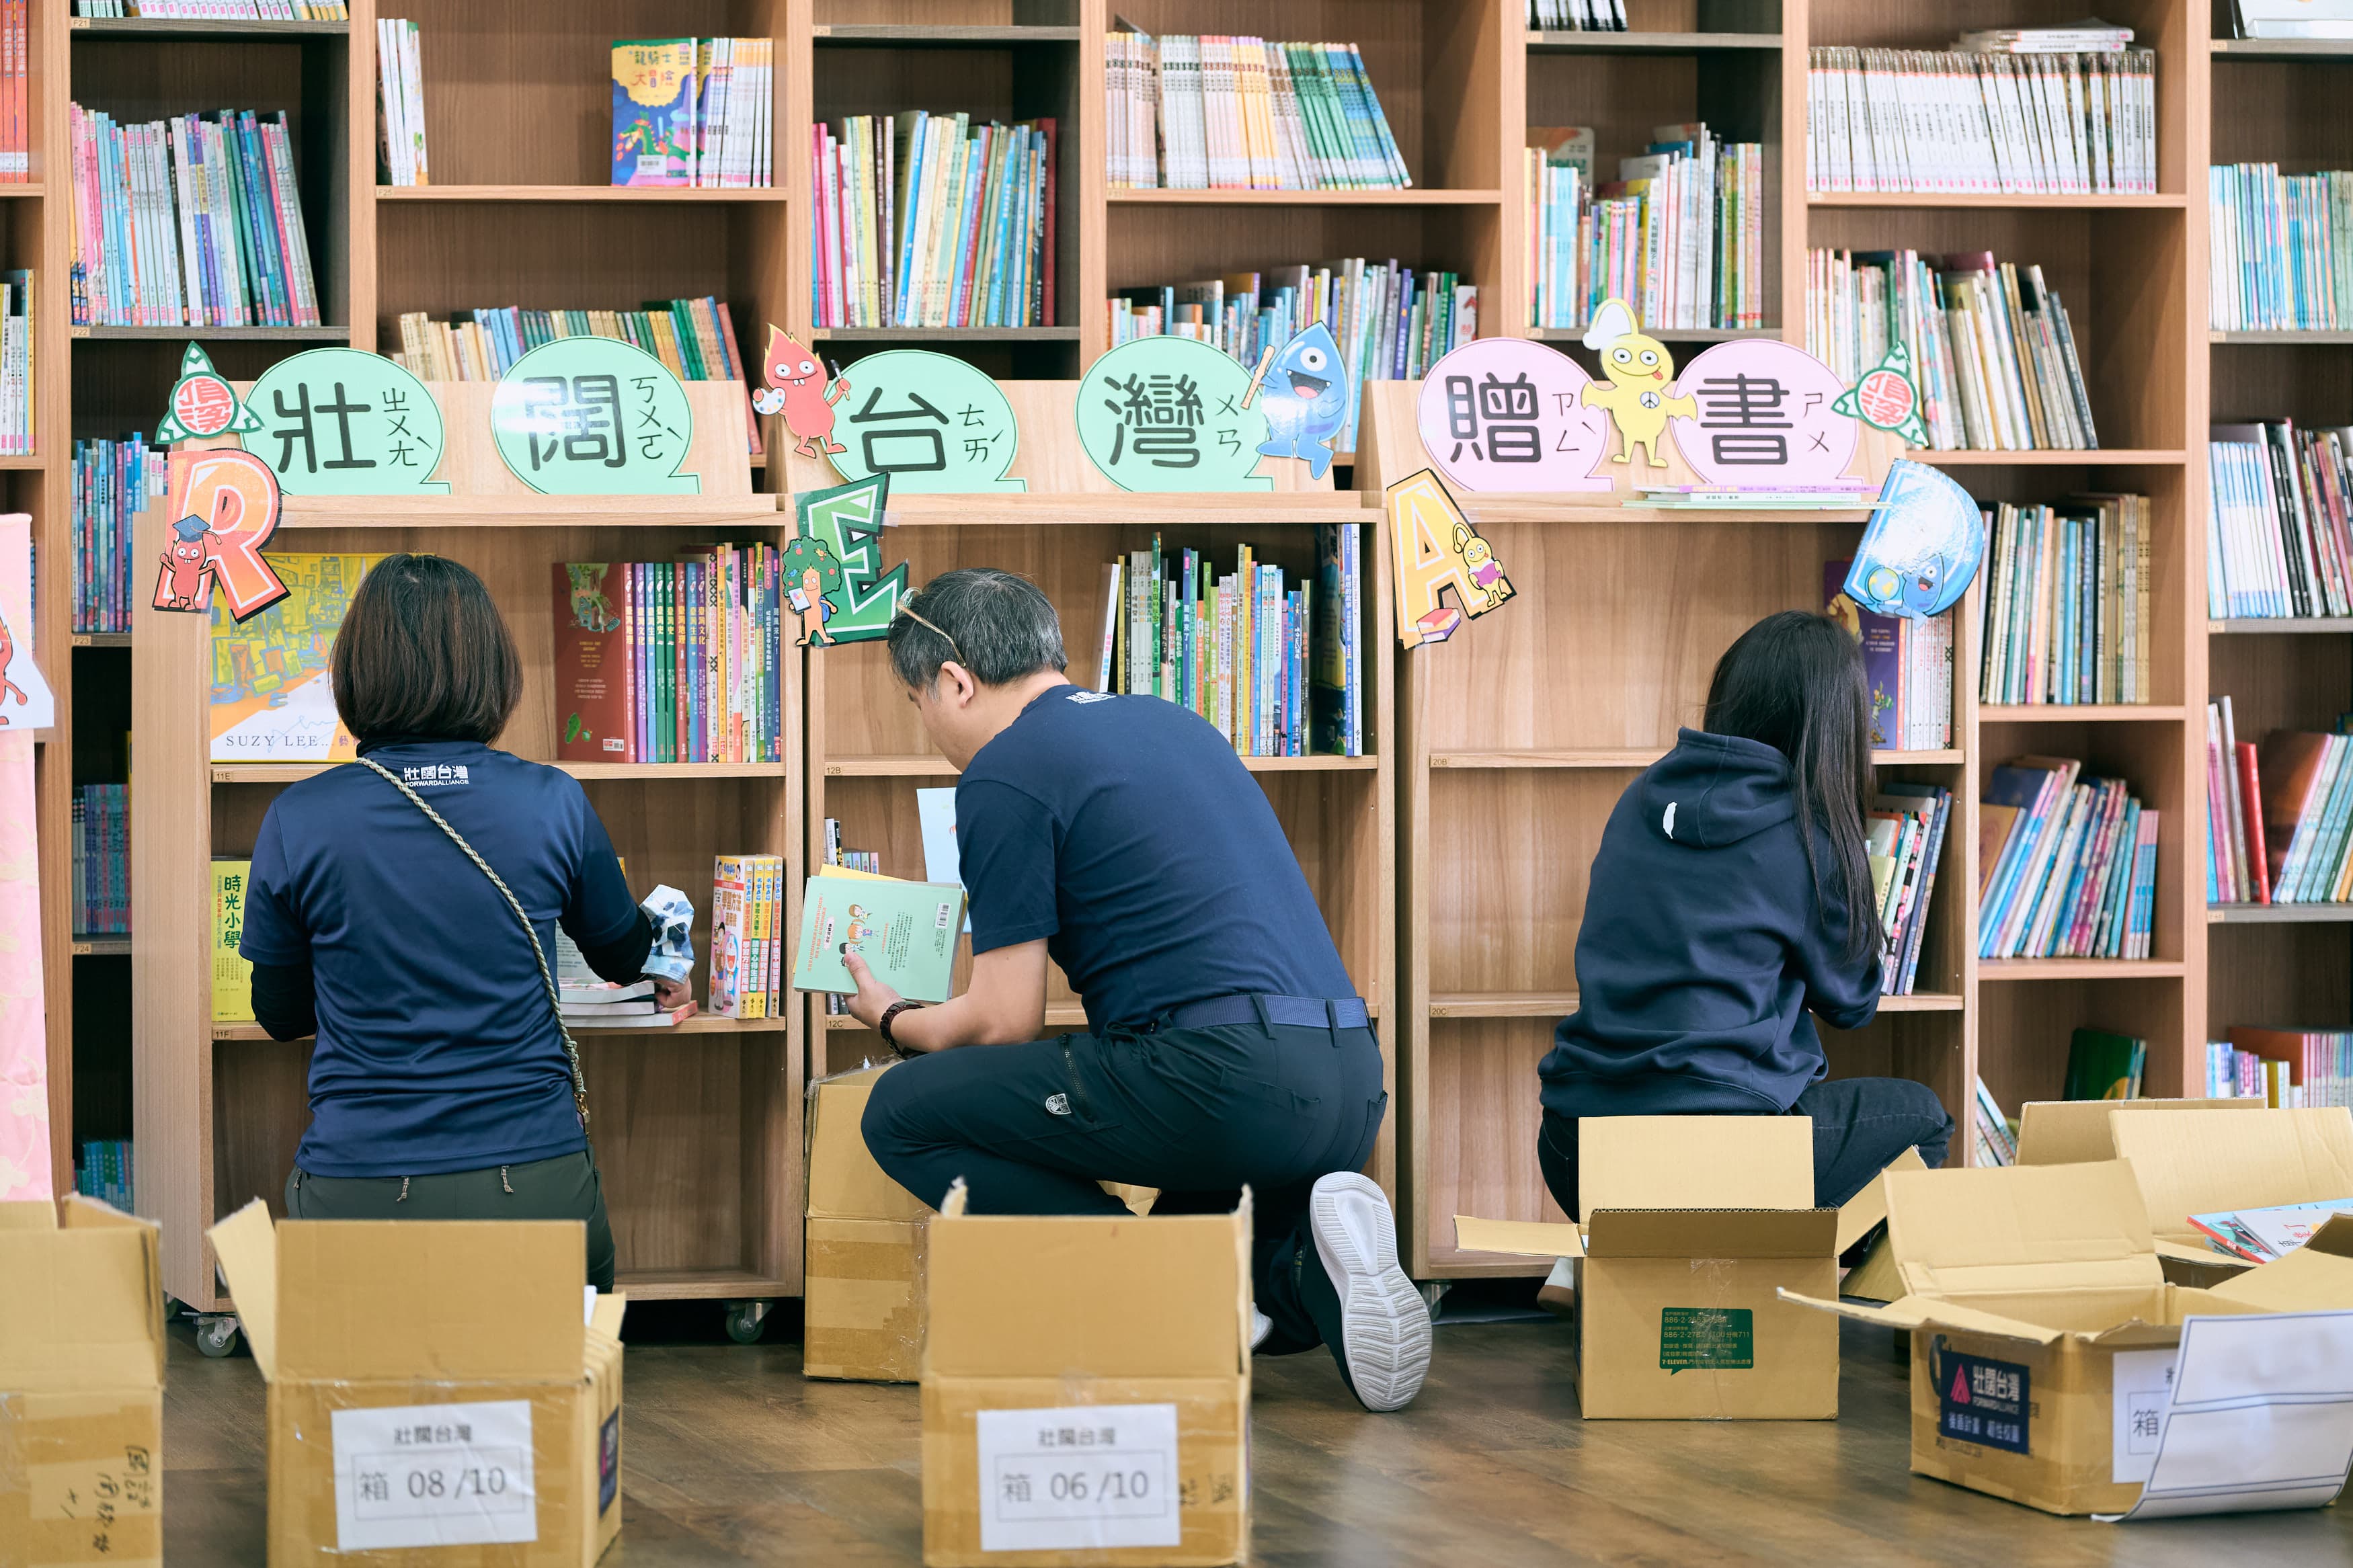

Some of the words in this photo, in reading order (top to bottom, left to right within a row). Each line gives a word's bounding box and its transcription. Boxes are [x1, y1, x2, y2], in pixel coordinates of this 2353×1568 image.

[631, 70, 675, 88] 大冒險
[273, 382, 377, 474] 壯
[522, 374, 626, 471] 闊
[850, 386, 949, 472] 台
[1103, 372, 1204, 468] 灣
[1445, 371, 1542, 464] 贈
[1696, 373, 1794, 465] 書
[153, 448, 291, 625] R
[794, 472, 908, 643] E
[1387, 468, 1517, 649] A
[227, 736, 275, 747] SUZY
[403, 764, 469, 782] 壯闊台灣
[826, 766, 841, 774] 12B
[75, 944, 89, 953] F24
[224, 874, 241, 949] 時光小學
[215, 1030, 229, 1038] 11F
[2132, 1409, 2159, 1438] 箱
[360, 1472, 389, 1502] 箱
[407, 1471, 445, 1499] 08
[1002, 1473, 1032, 1503] 箱
[1051, 1472, 1087, 1501] 06
